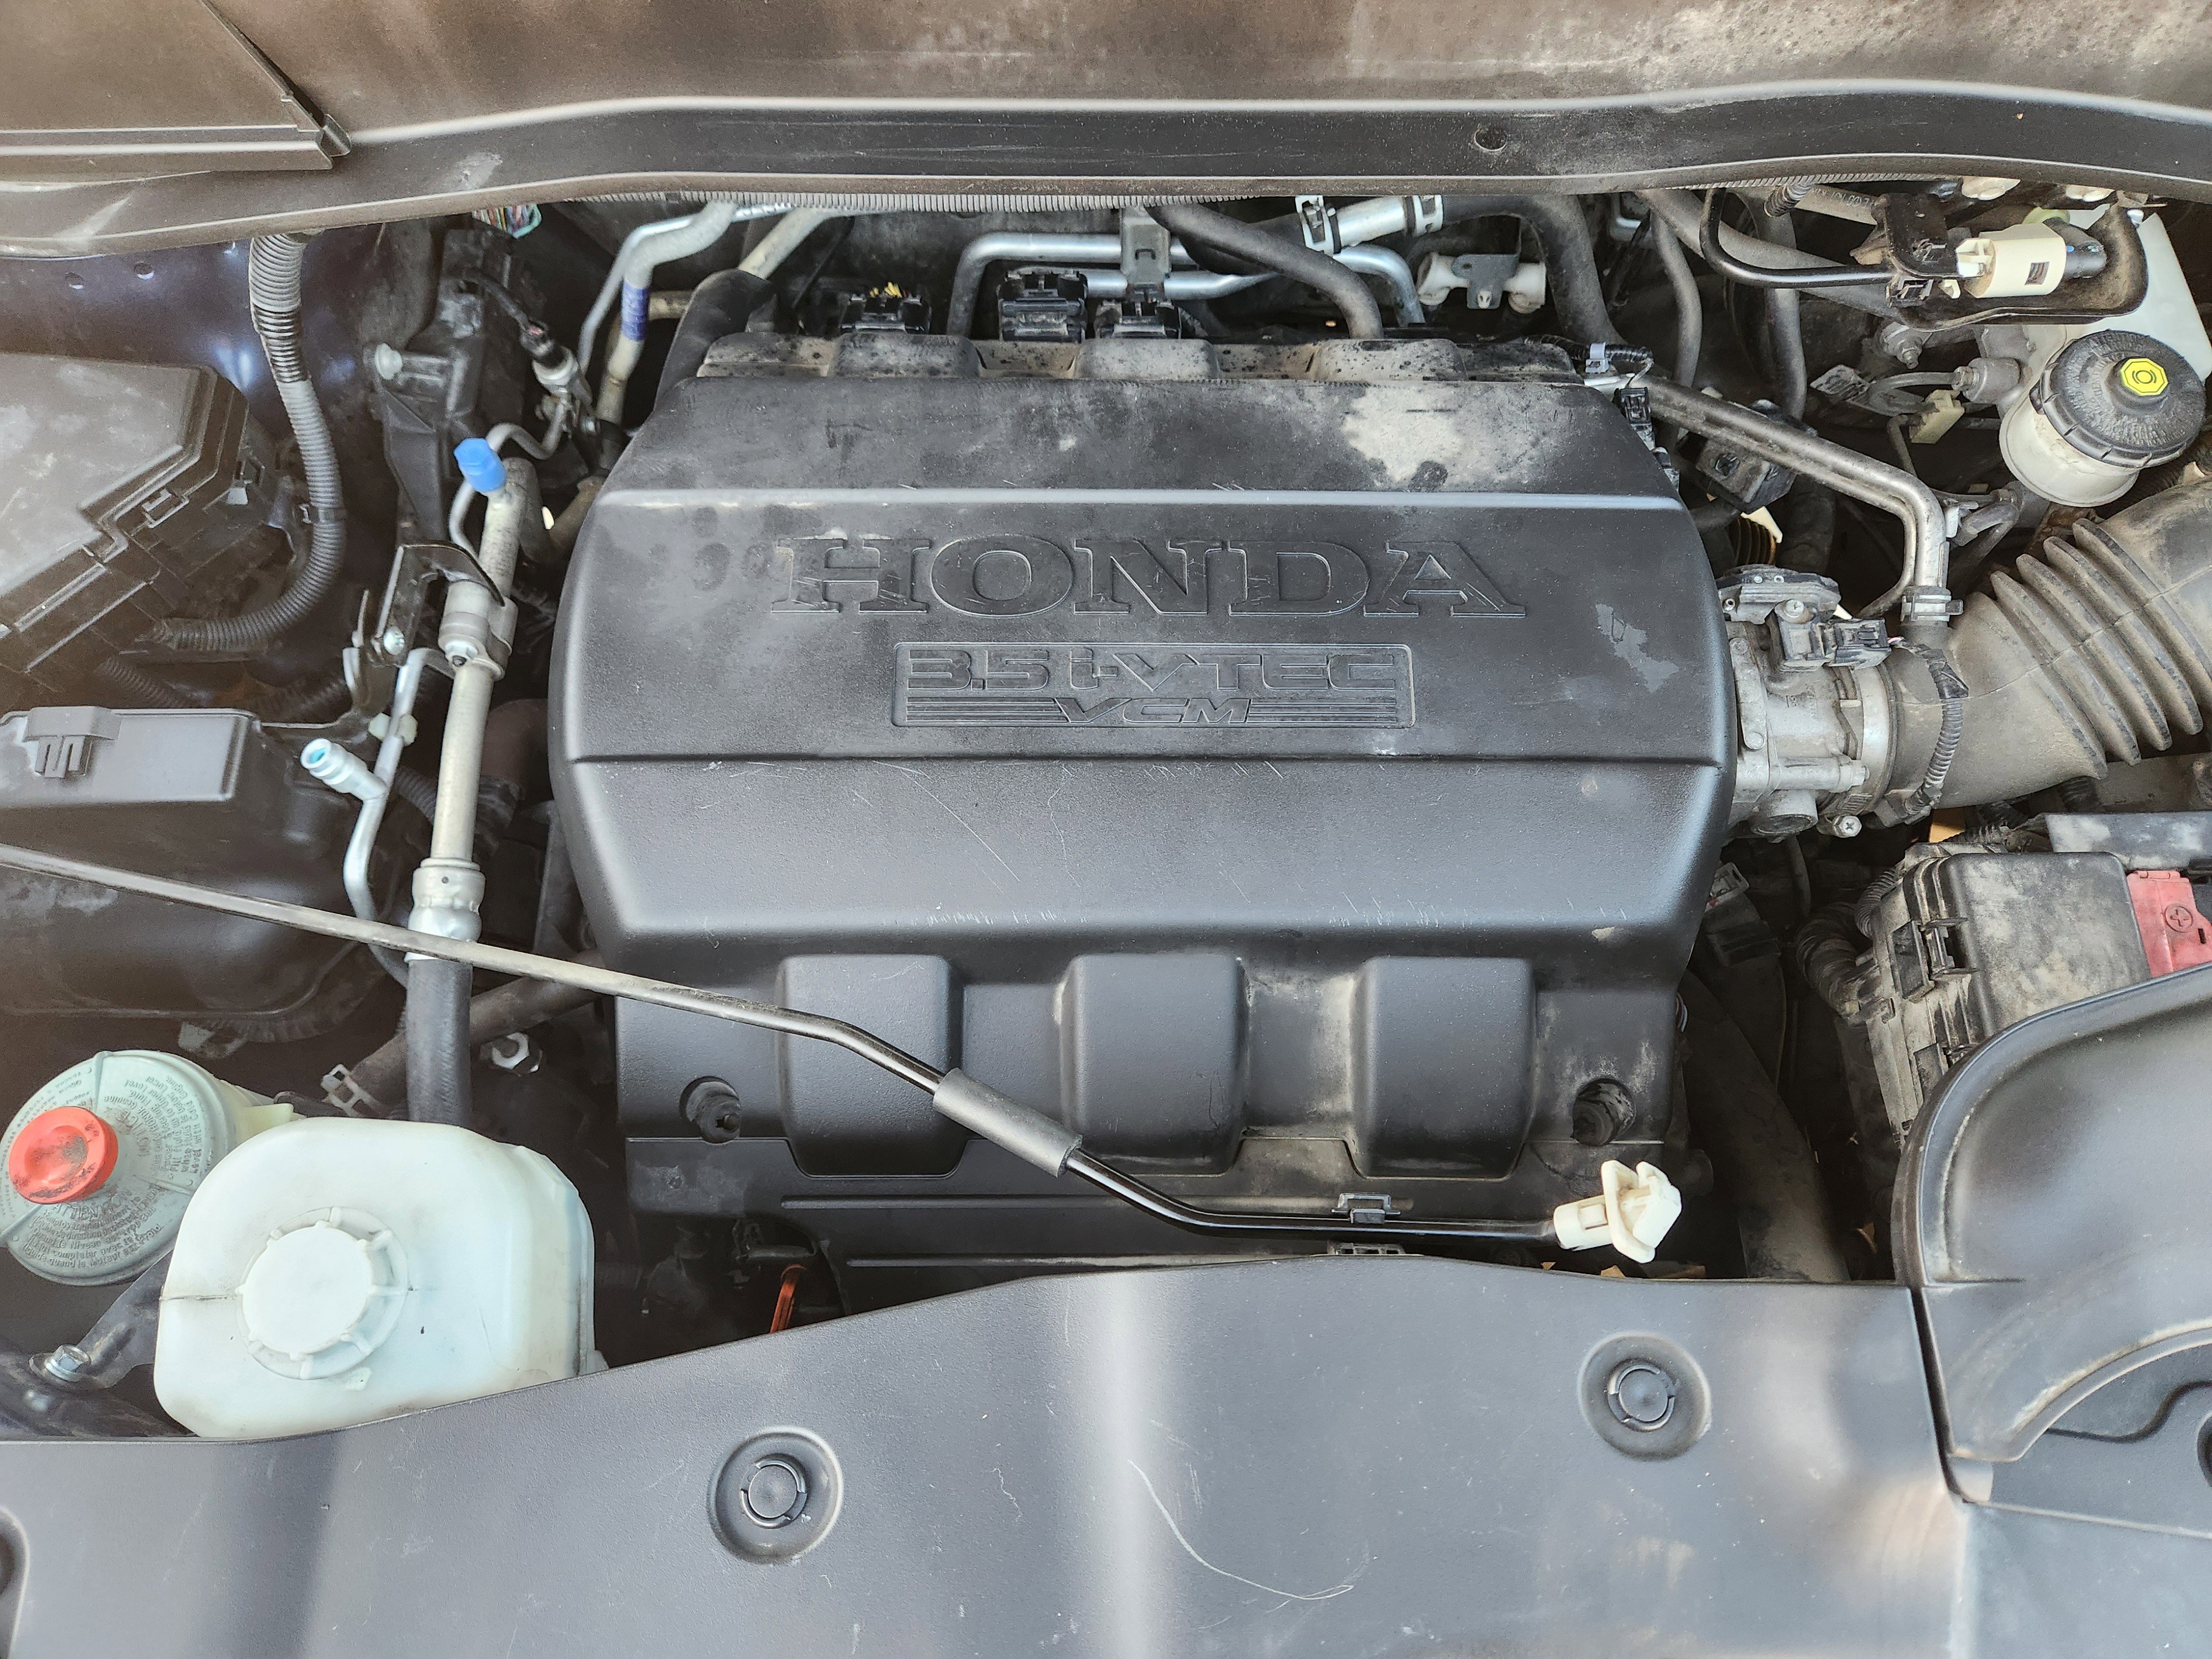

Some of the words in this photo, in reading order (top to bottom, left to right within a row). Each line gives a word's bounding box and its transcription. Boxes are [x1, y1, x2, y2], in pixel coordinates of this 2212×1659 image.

[771, 534, 1527, 619] HONDA
[907, 649, 1050, 691] 3.5
[1070, 648, 1396, 692] i-VTEC
[1054, 698, 1252, 724] VCM
[103, 1095, 138, 1110] Genuine
[137, 1106, 159, 1132] HONDA
